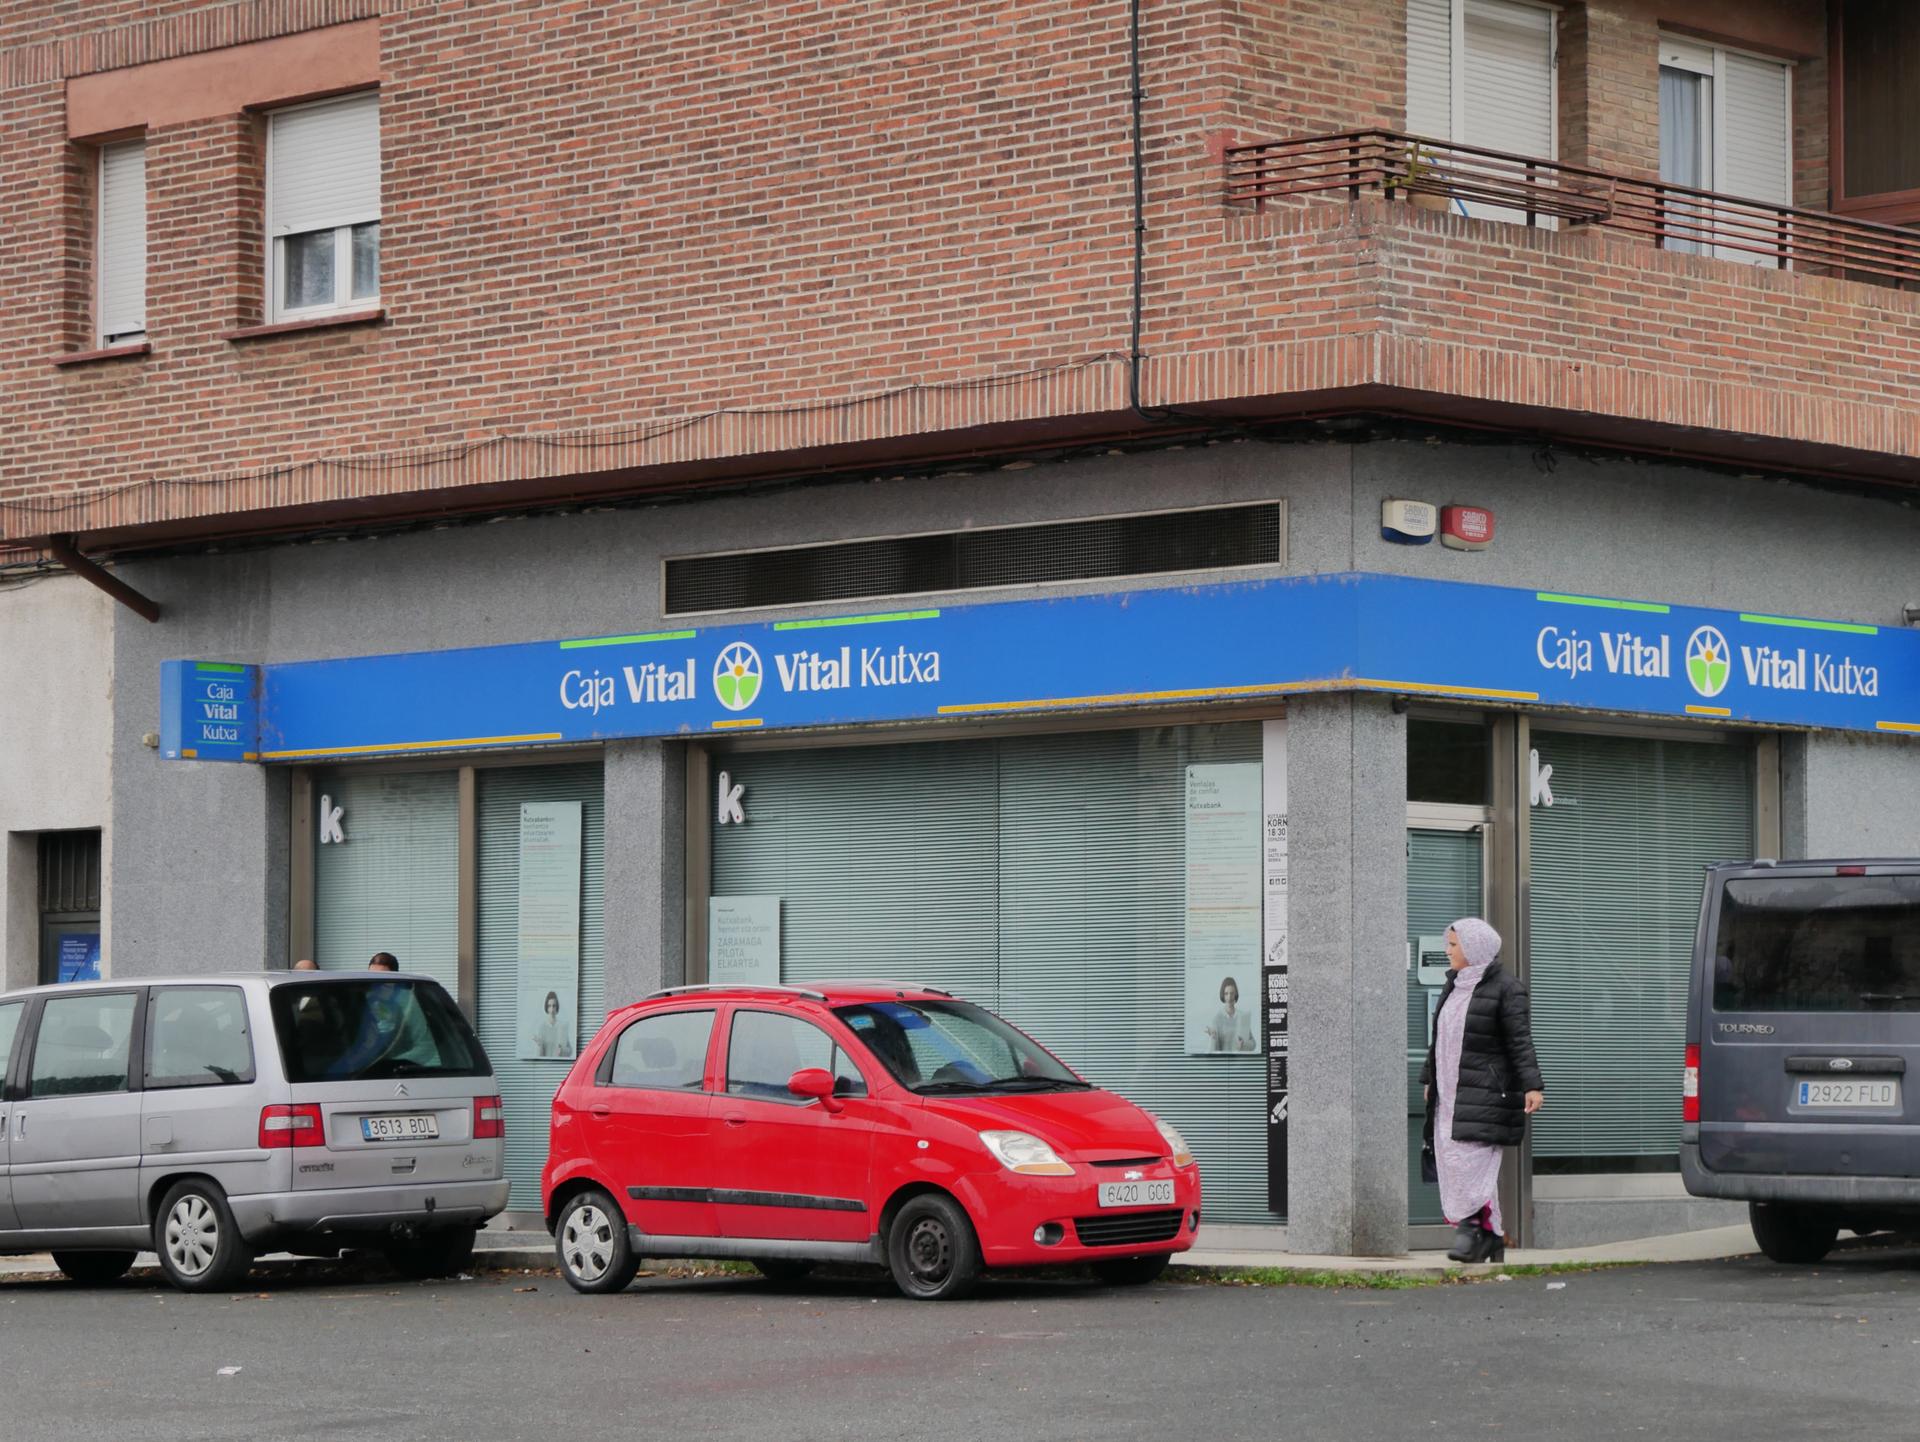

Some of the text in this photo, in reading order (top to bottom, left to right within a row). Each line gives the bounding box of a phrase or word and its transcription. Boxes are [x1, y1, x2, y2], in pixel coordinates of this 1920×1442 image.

[1536, 626, 1878, 696] Caja Vital Vital Kutxa
[560, 645, 940, 715] Caja Vital Vital Kutxa
[207, 683, 234, 702] Caja
[203, 704, 238, 720] Vital
[203, 724, 237, 741] Kutxa
[1268, 819, 1288, 827] KORN
[717, 936, 762, 947] ZARAMAGA
[717, 948, 745, 958] PILOTA
[717, 958, 760, 968] ELKARTEA
[1268, 980, 1288, 988] KORN
[1719, 1023, 1775, 1034] TOURNEO
[1811, 1085, 1891, 1102] 2922 FLD
[371, 1118, 435, 1135] 3613 BDL
[1108, 1183, 1170, 1202] 6420 GCG
